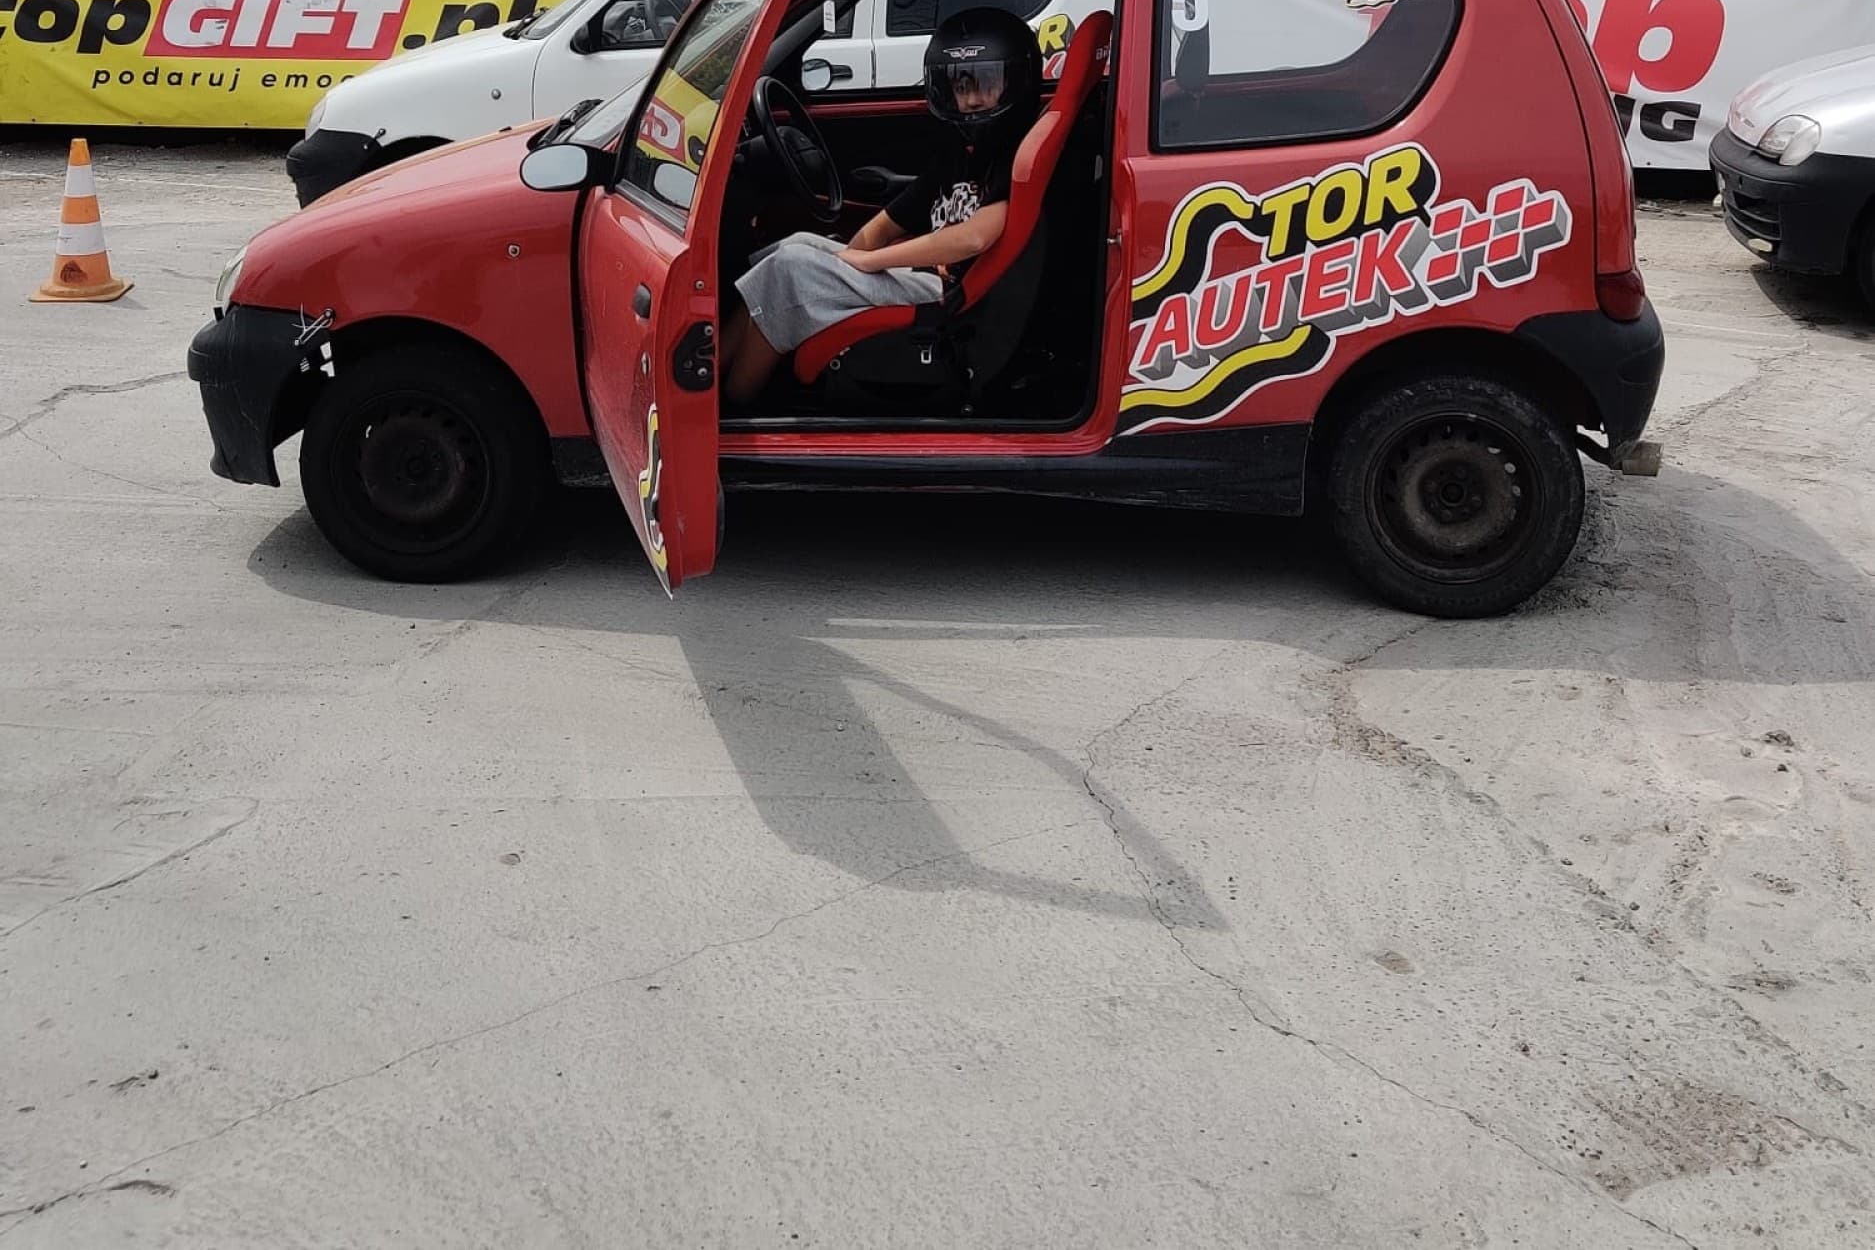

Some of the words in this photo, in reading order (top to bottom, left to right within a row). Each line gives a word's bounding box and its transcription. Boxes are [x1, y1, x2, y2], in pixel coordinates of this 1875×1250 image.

[92, 66, 241, 92] podaruj
[1259, 146, 1430, 260] TOR
[1137, 218, 1418, 370] AUTEK
